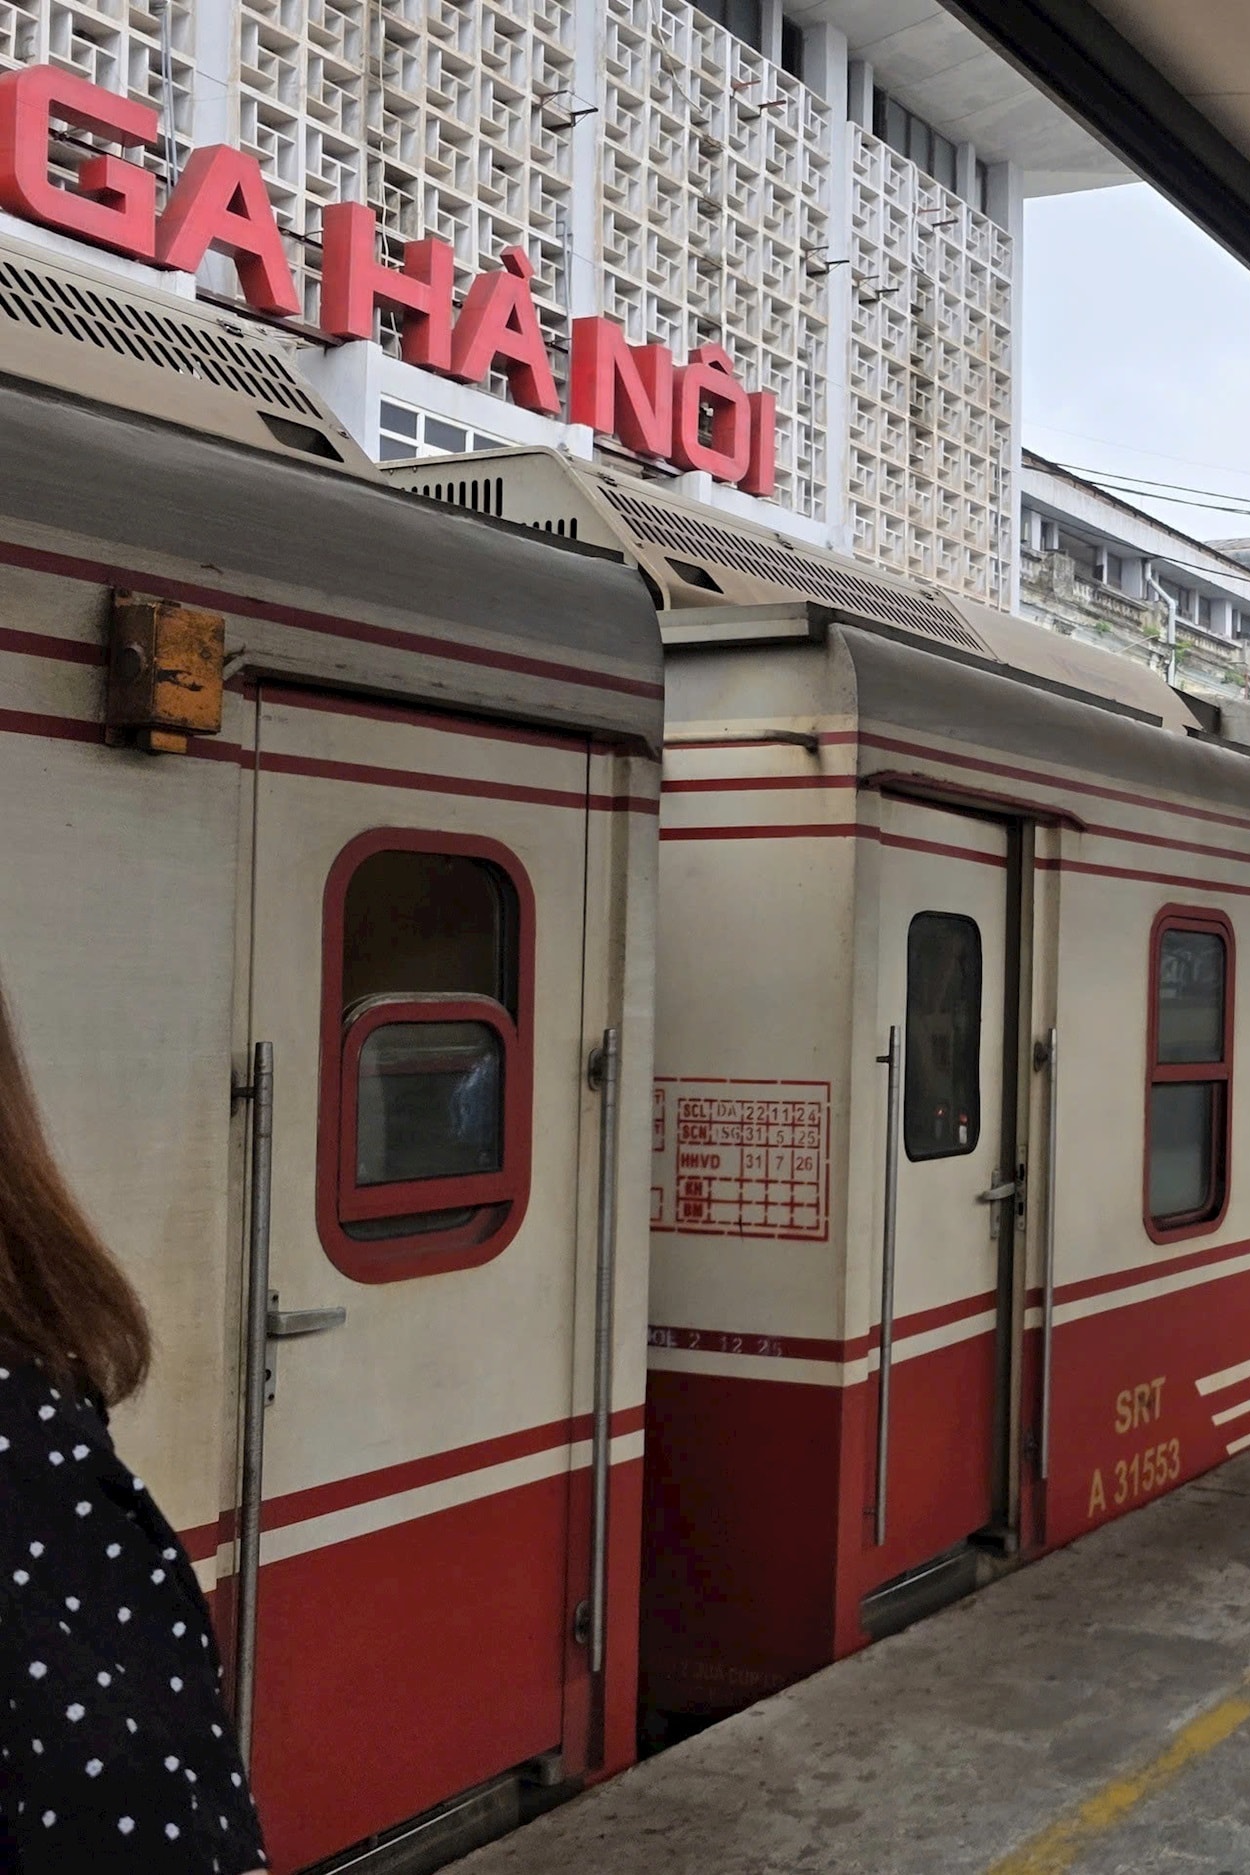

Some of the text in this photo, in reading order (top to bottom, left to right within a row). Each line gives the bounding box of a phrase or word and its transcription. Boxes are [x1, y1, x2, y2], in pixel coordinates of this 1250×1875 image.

[0, 64, 300, 316] GA
[320, 201, 562, 416] HÀ
[684, 1104, 706, 1118] SCL
[746, 1107, 765, 1121] 22
[797, 1110, 816, 1123] 24
[745, 1127, 763, 1141] 31
[776, 1131, 784, 1144] 5
[799, 1131, 816, 1144] 25
[746, 1154, 762, 1169] 31
[776, 1156, 784, 1170] 7
[796, 1157, 813, 1171] 26
[1115, 1376, 1166, 1434] SRT
[1087, 1438, 1180, 1518] A 31553
